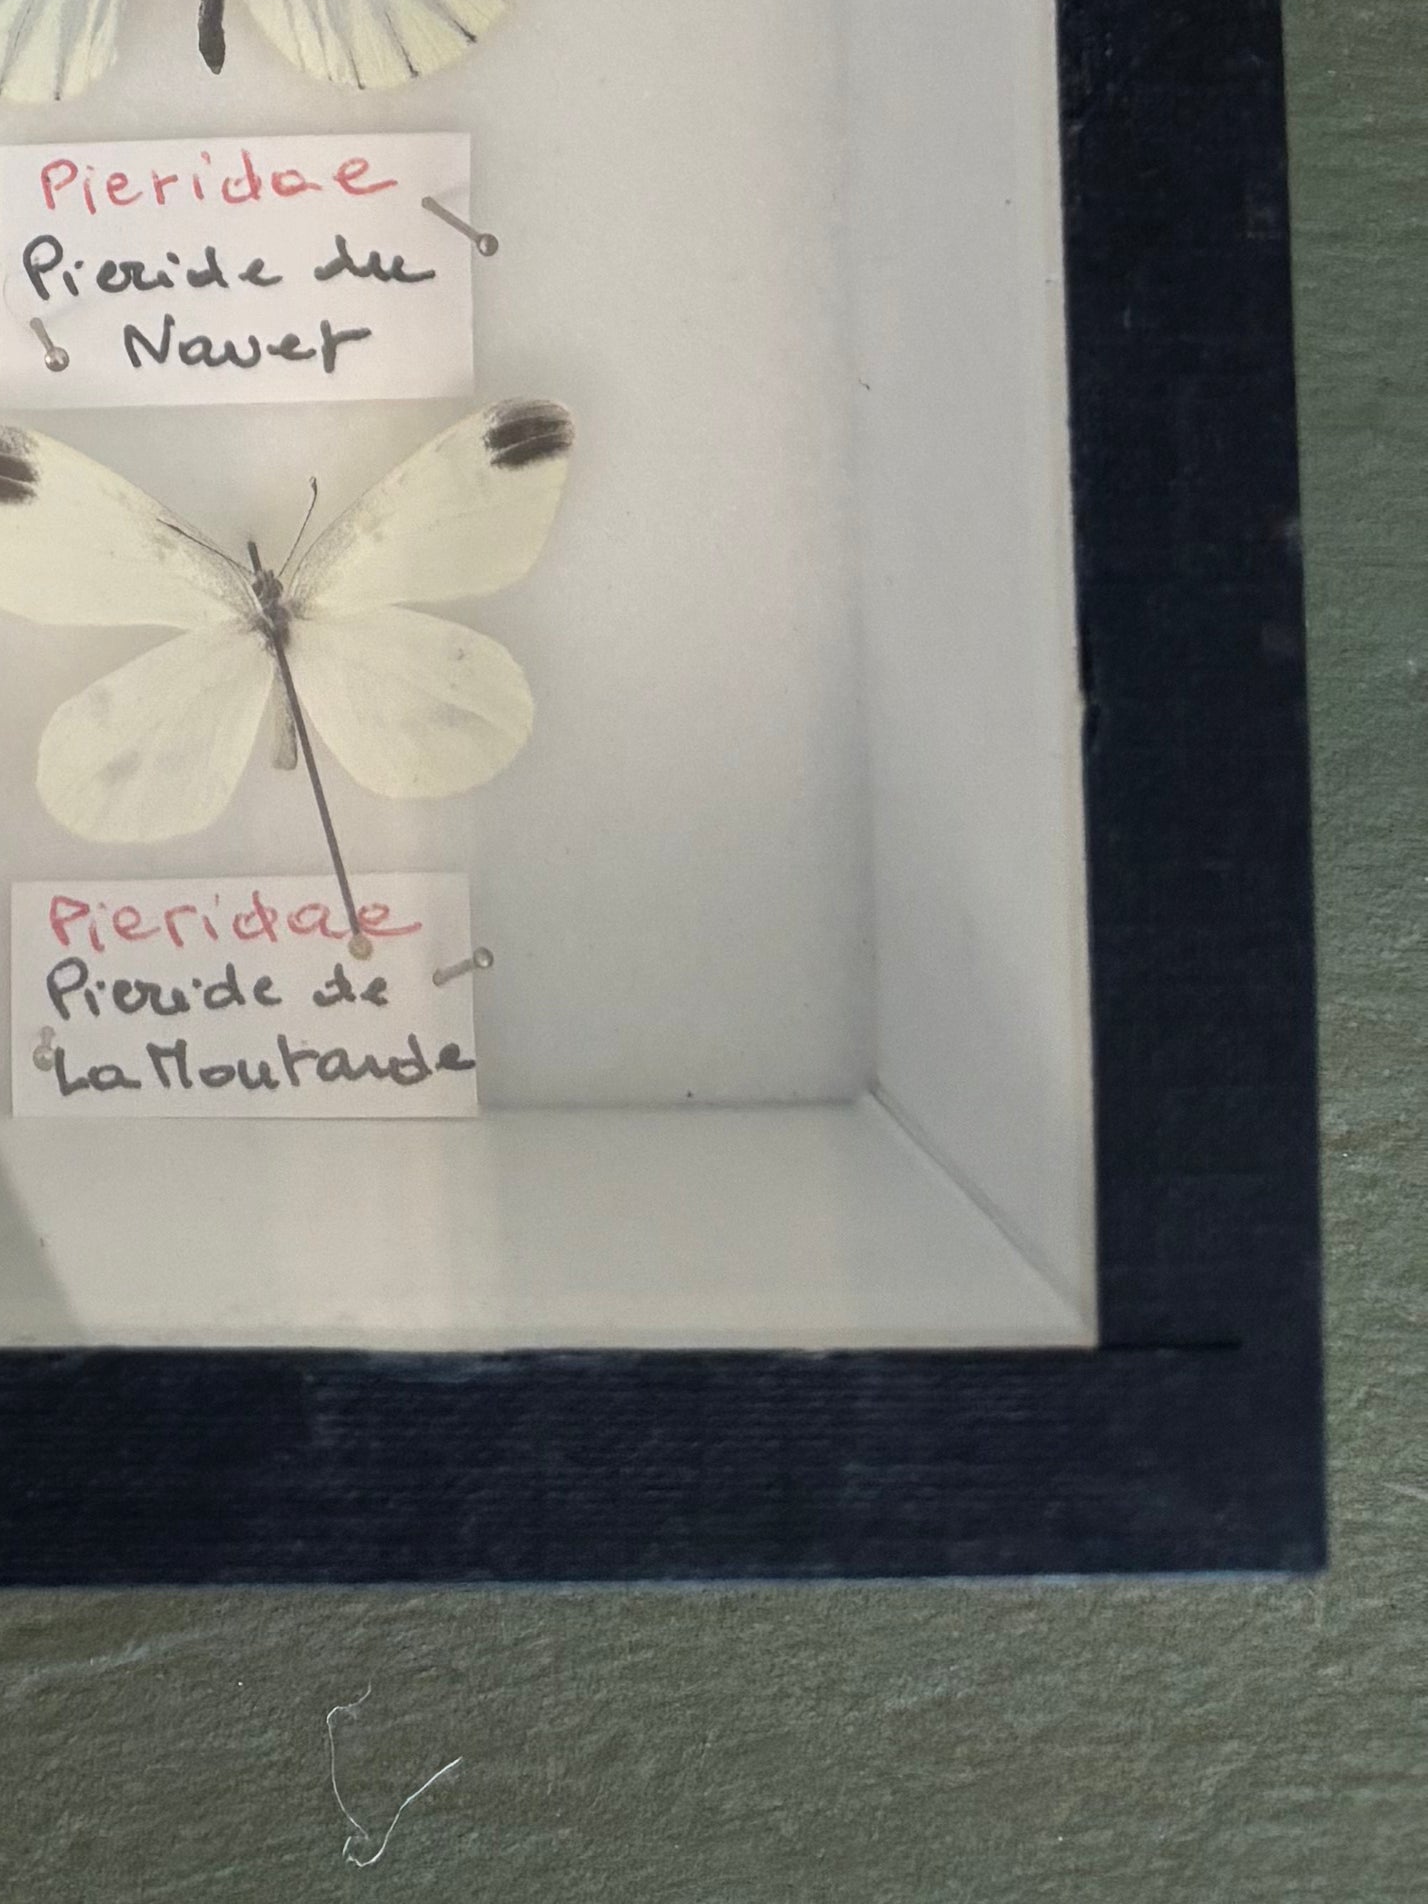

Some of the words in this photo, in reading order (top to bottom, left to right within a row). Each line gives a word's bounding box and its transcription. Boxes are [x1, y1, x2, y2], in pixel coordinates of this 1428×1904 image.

[40, 149, 398, 215] Pieridae
[314, 234, 436, 284] du
[123, 313, 373, 374] Navet
[48, 890, 424, 953] Pieridae
[312, 962, 389, 1008] de
